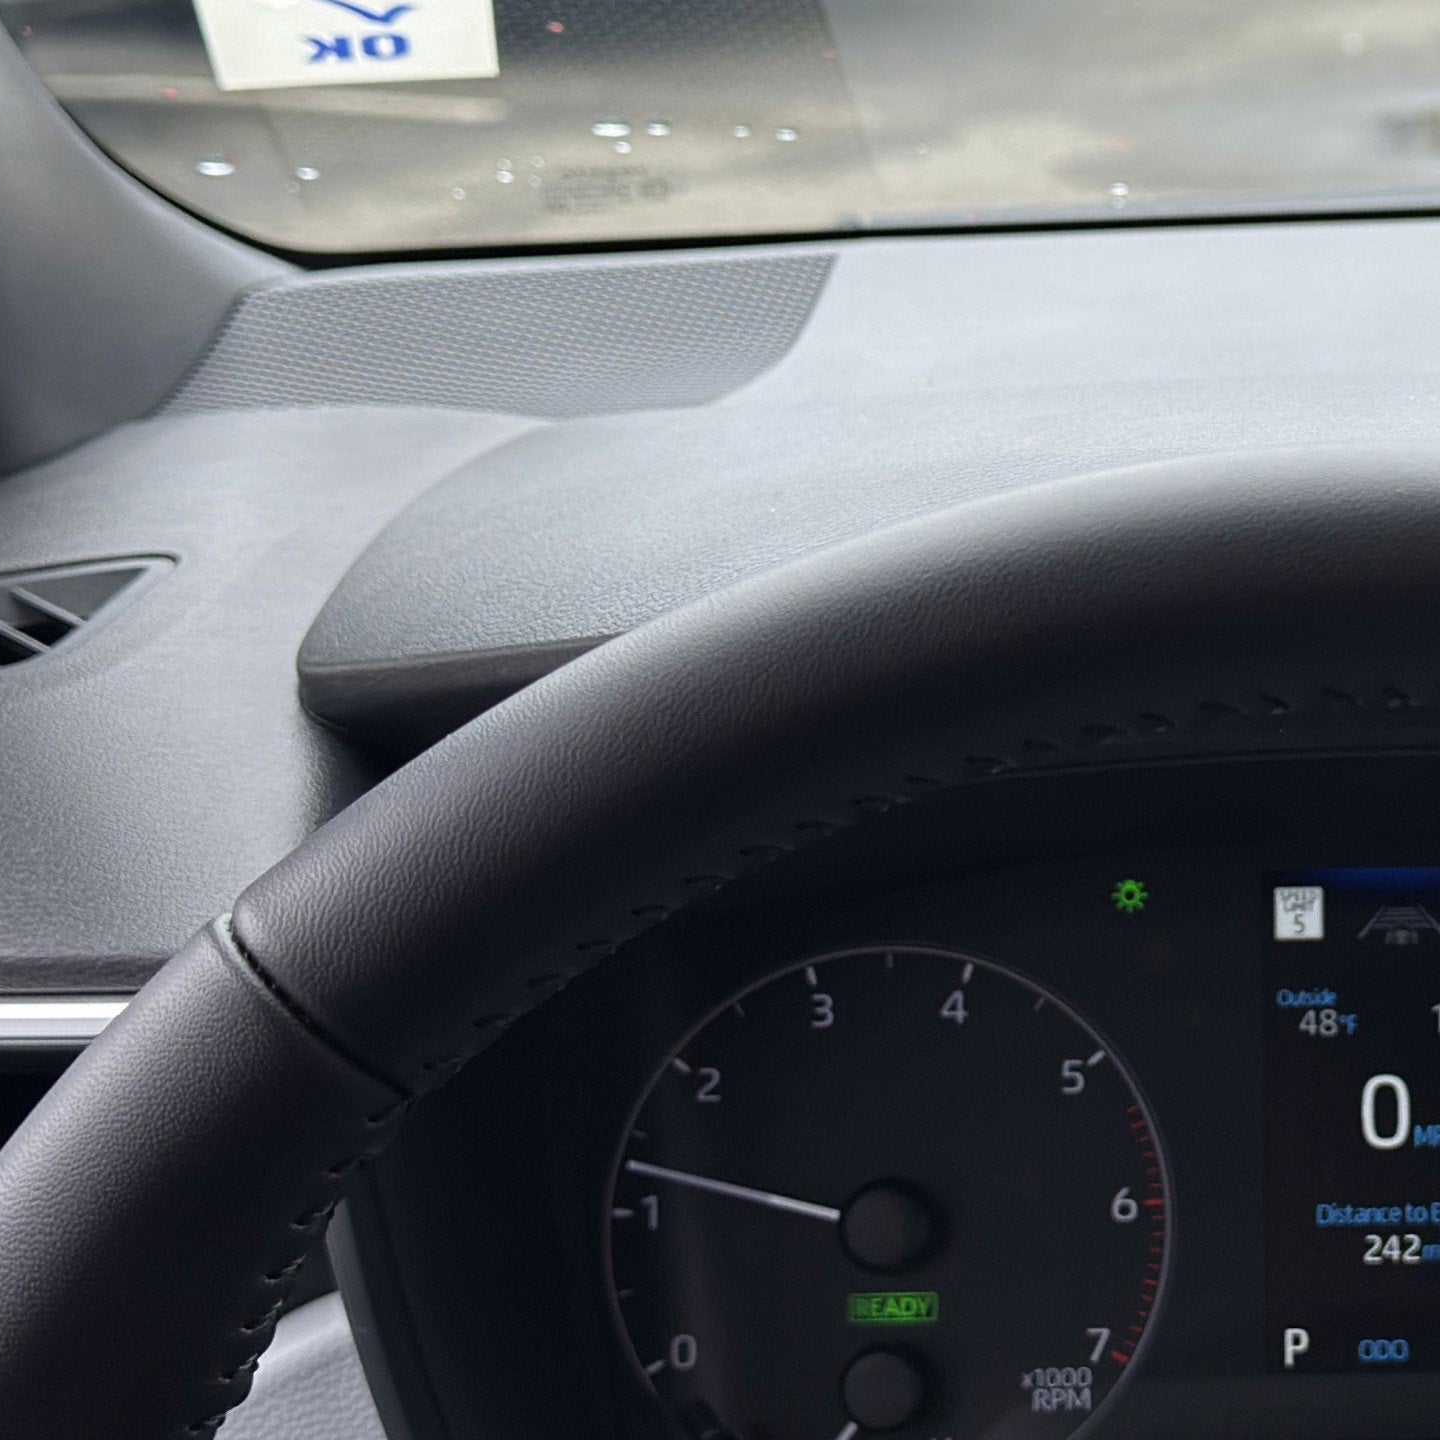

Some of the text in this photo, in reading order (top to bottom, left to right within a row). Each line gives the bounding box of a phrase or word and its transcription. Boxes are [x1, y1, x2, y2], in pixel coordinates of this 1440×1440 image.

[812, 996, 834, 1028] 3
[941, 990, 968, 1022] 4
[696, 1069, 721, 1101] 2
[1063, 1062, 1083, 1093] 5
[1362, 1075, 1410, 1149] 0
[641, 1195, 657, 1229] 1
[1112, 1188, 1138, 1222] 6
[1316, 1203, 1403, 1227] Distance
[1405, 1203, 1429, 1224] to
[857, 1297, 933, 1317] READY
[671, 1335, 697, 1369] 0
[1086, 1328, 1110, 1363] 7
[1284, 1328, 1310, 1368] P
[1032, 1388, 1091, 1411] RPM
